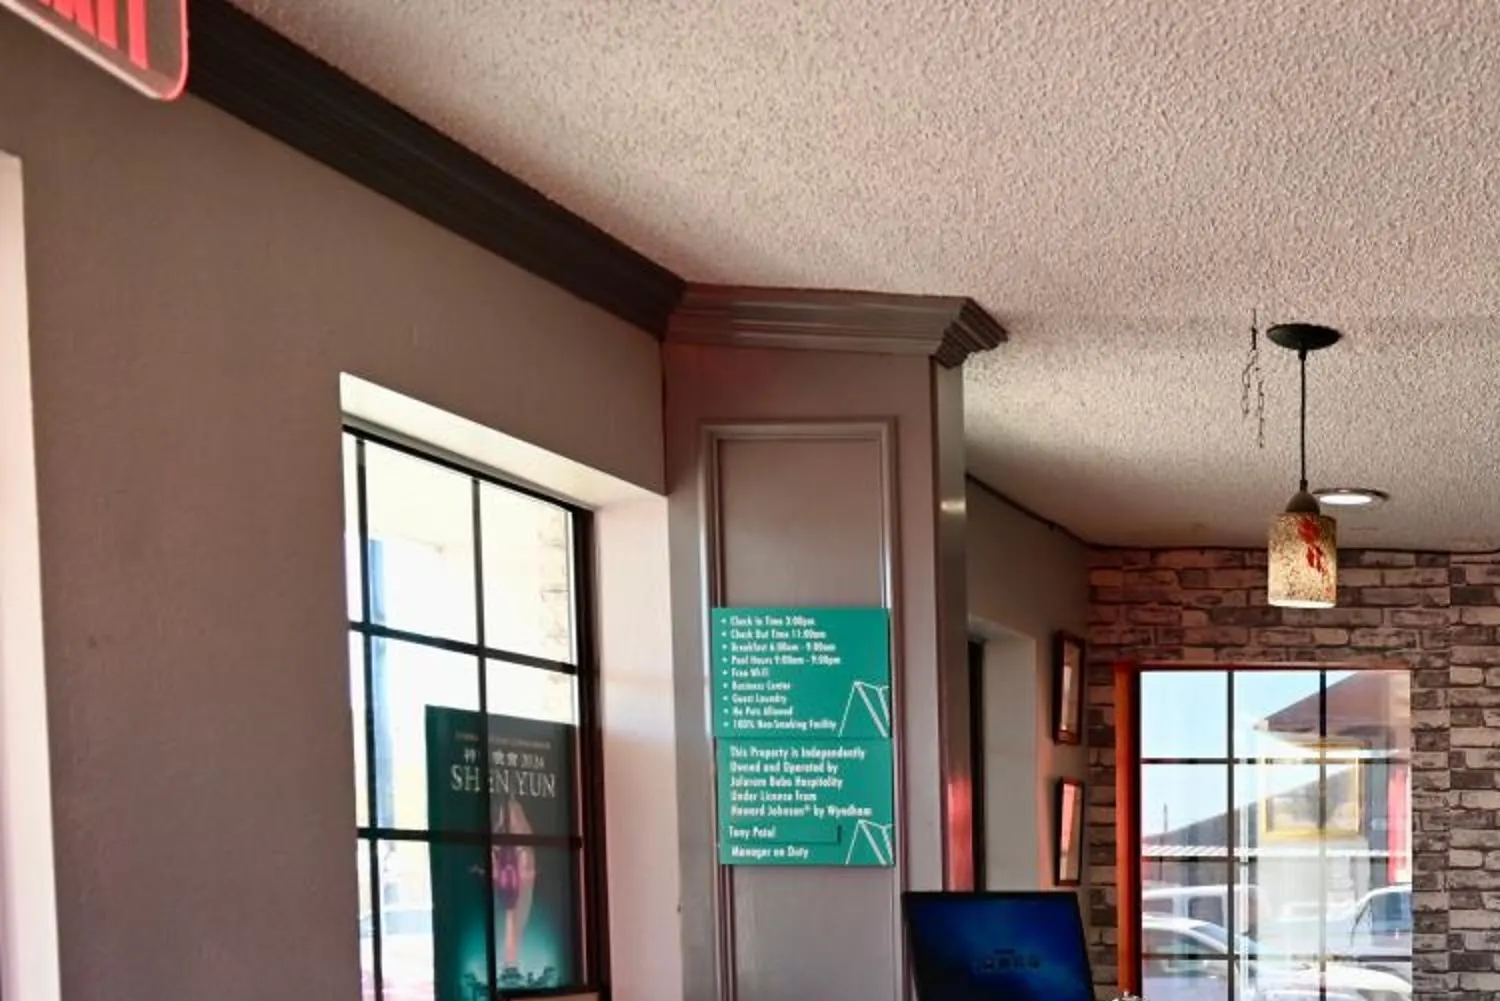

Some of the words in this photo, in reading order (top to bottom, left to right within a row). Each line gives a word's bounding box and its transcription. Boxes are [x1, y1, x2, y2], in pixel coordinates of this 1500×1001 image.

[730, 615, 753, 626] Check
[765, 616, 784, 626] Time
[730, 628, 754, 640] Check
[755, 629, 770, 640] Out
[771, 629, 789, 640] Time
[731, 641, 768, 652] Breakfast
[731, 654, 749, 665] Pool
[750, 655, 773, 665] Hours
[731, 667, 749, 677] Free
[731, 680, 765, 691] Business
[766, 680, 792, 691] Center
[731, 693, 754, 704] Guest
[755, 693, 788, 706] Laundry
[732, 706, 743, 716] No
[745, 706, 762, 716] Pets
[763, 705, 794, 716] Allowed
[733, 719, 754, 730] 100%
[809, 718, 837, 732] Facility
[729, 745, 749, 758] This
[750, 747, 789, 760] Property
[801, 746, 866, 761] Independently
[730, 760, 761, 773] Owned
[763, 761, 781, 773] and
[783, 761, 825, 775] Operated
[826, 760, 839, 775] by
[514, 770, 556, 799] YUN
[794, 775, 844, 791] Hospitality
[731, 790, 758, 802] Under
[760, 790, 793, 802] License
[794, 789, 817, 801] from
[730, 804, 765, 817] Howard
[812, 804, 826, 820] by
[827, 803, 873, 820] Wyndham
[728, 824, 750, 840] Tony
[752, 825, 777, 838] Patel
[731, 845, 771, 860] Manager
[773, 848, 785, 857] on
[787, 844, 810, 860] Duty
